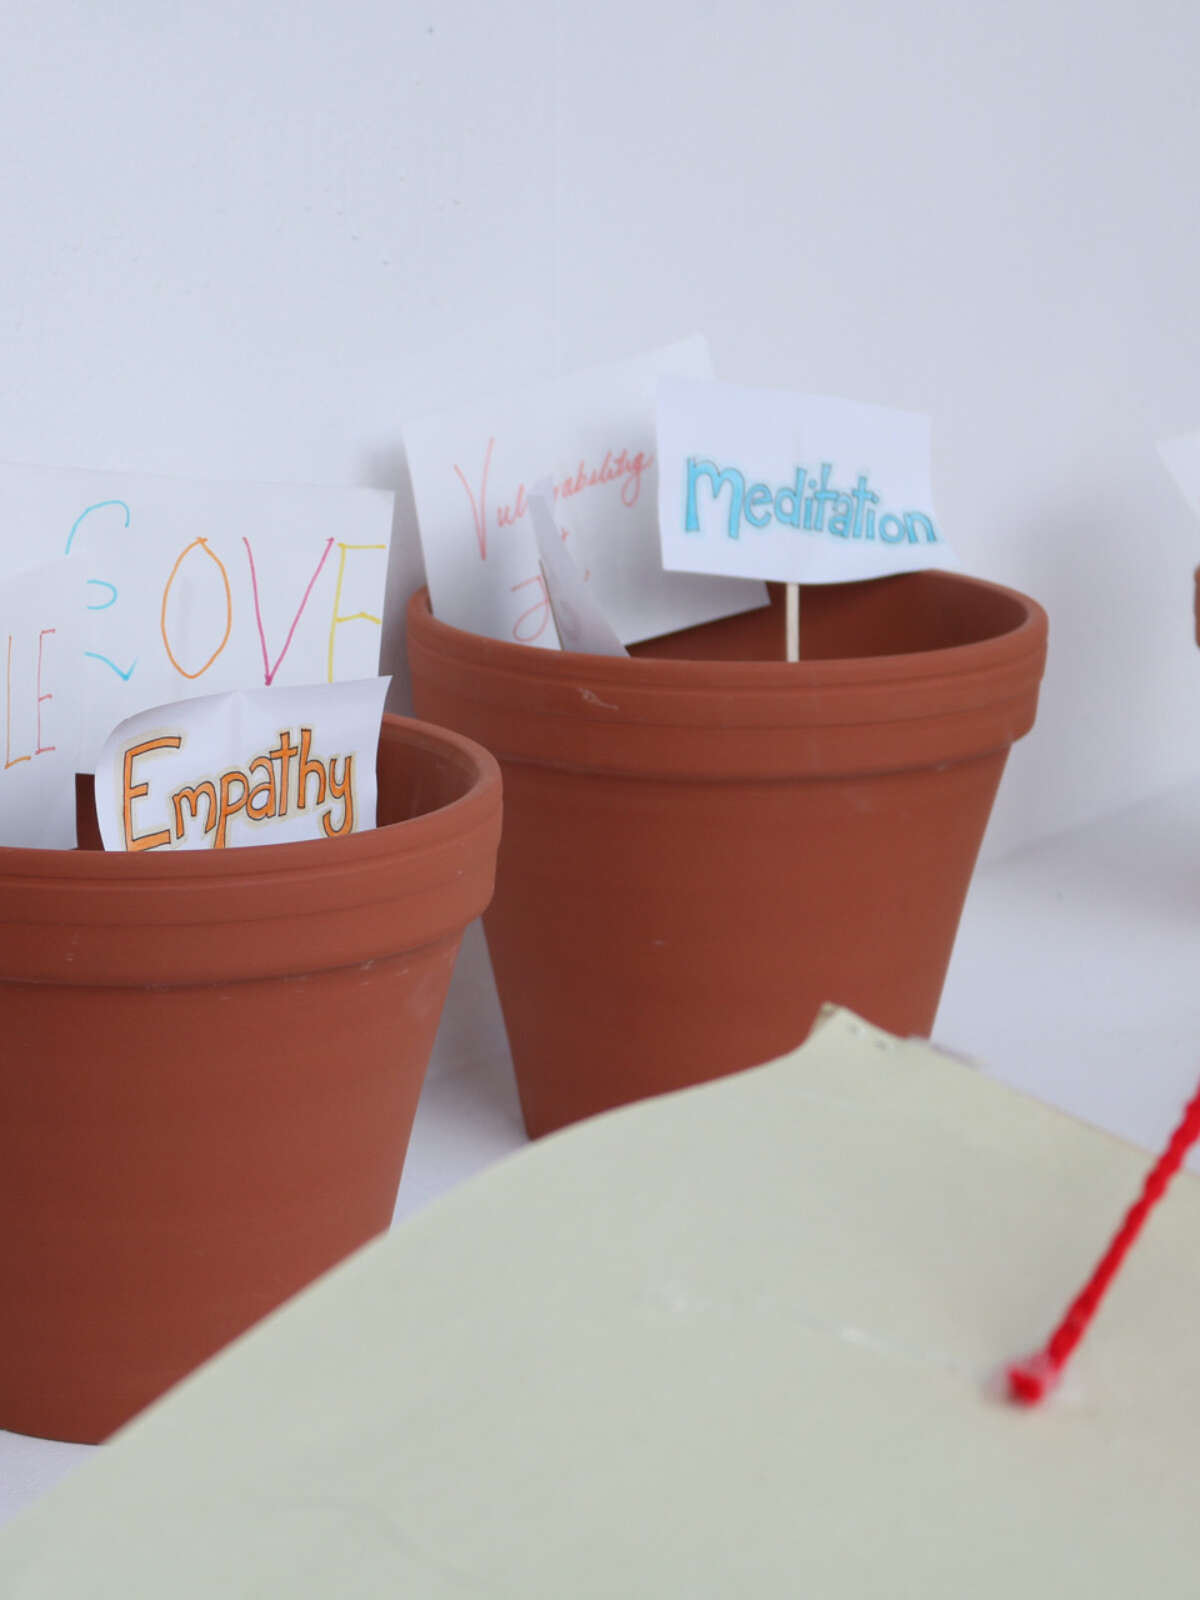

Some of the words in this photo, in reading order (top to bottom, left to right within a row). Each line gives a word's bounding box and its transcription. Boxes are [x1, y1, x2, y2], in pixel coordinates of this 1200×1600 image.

[453, 436, 656, 561] Vulrability
[684, 454, 939, 546] Meditation
[121, 728, 356, 853] Empathy
